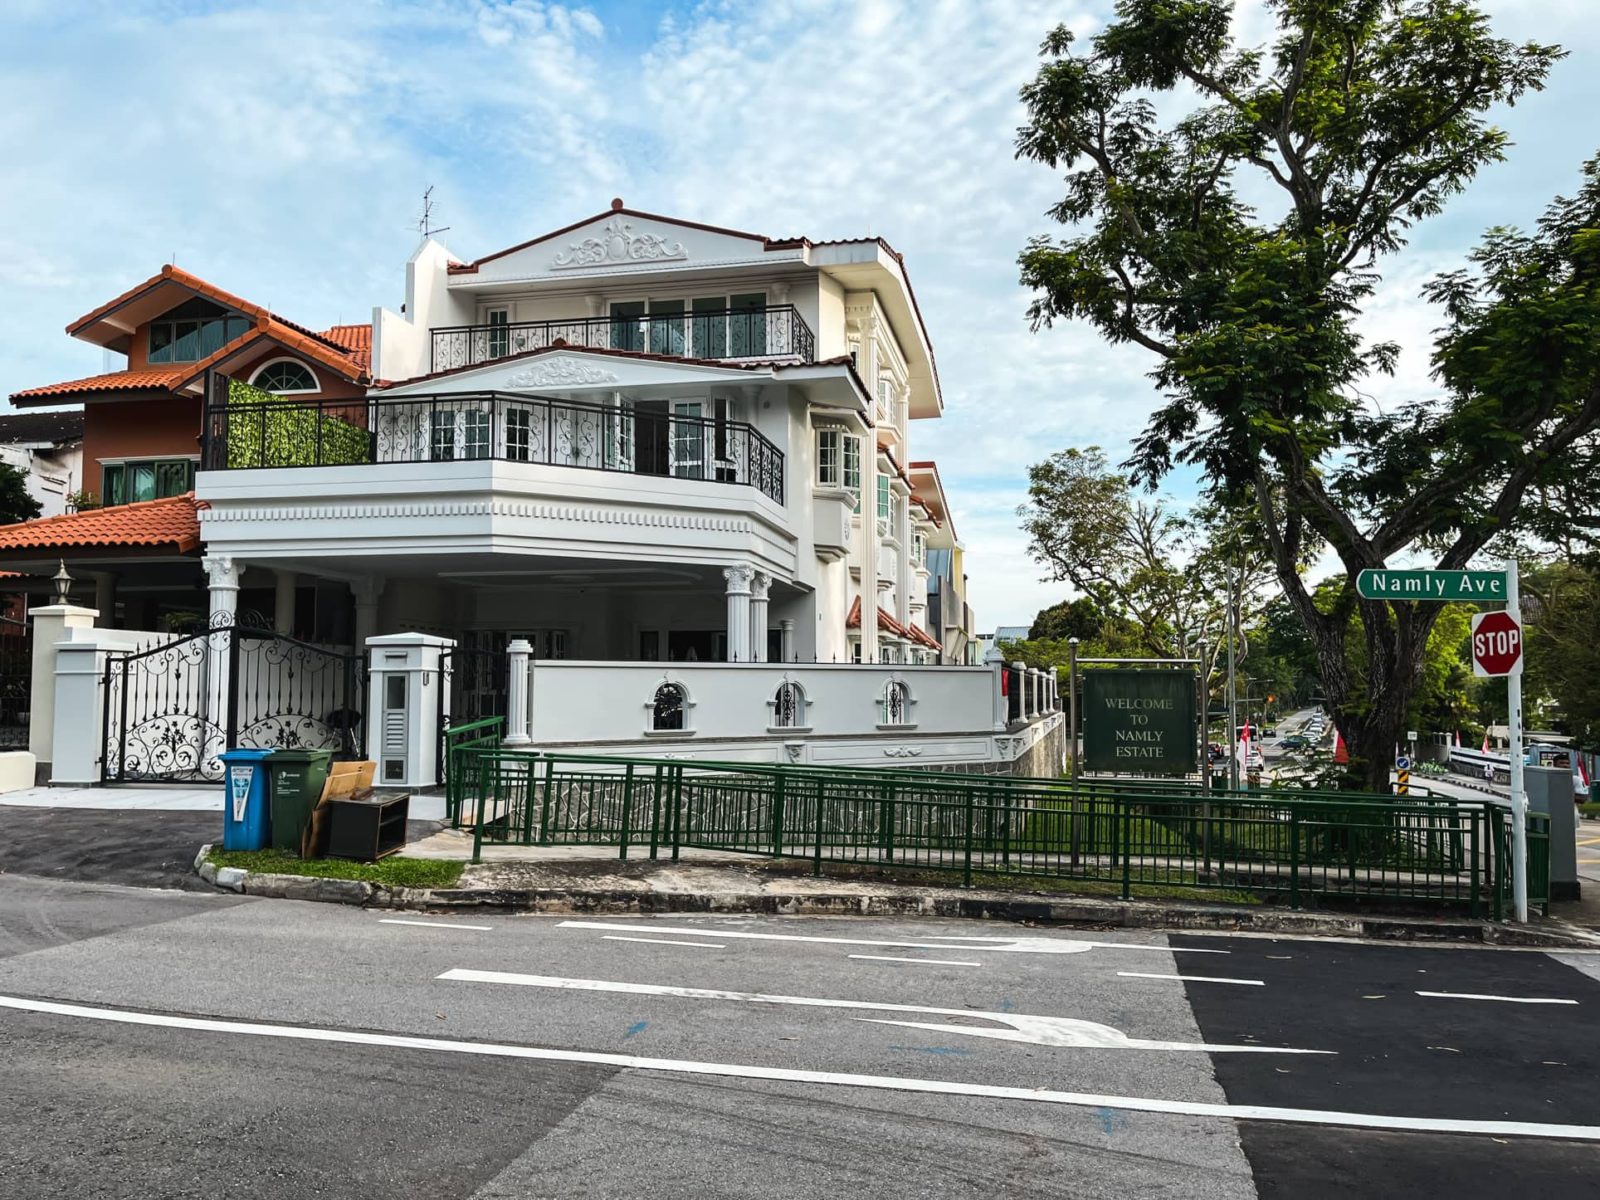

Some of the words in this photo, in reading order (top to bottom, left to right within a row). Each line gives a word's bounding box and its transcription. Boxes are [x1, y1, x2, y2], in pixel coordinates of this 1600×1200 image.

[1373, 573, 1445, 595] Namly
[1459, 575, 1500, 593] Ave
[1475, 629, 1518, 657] STOP
[1106, 698, 1173, 710] WELCOME
[1130, 714, 1148, 725] TO
[1116, 730, 1163, 742] NAMLY
[1116, 746, 1164, 758] ESTATE
